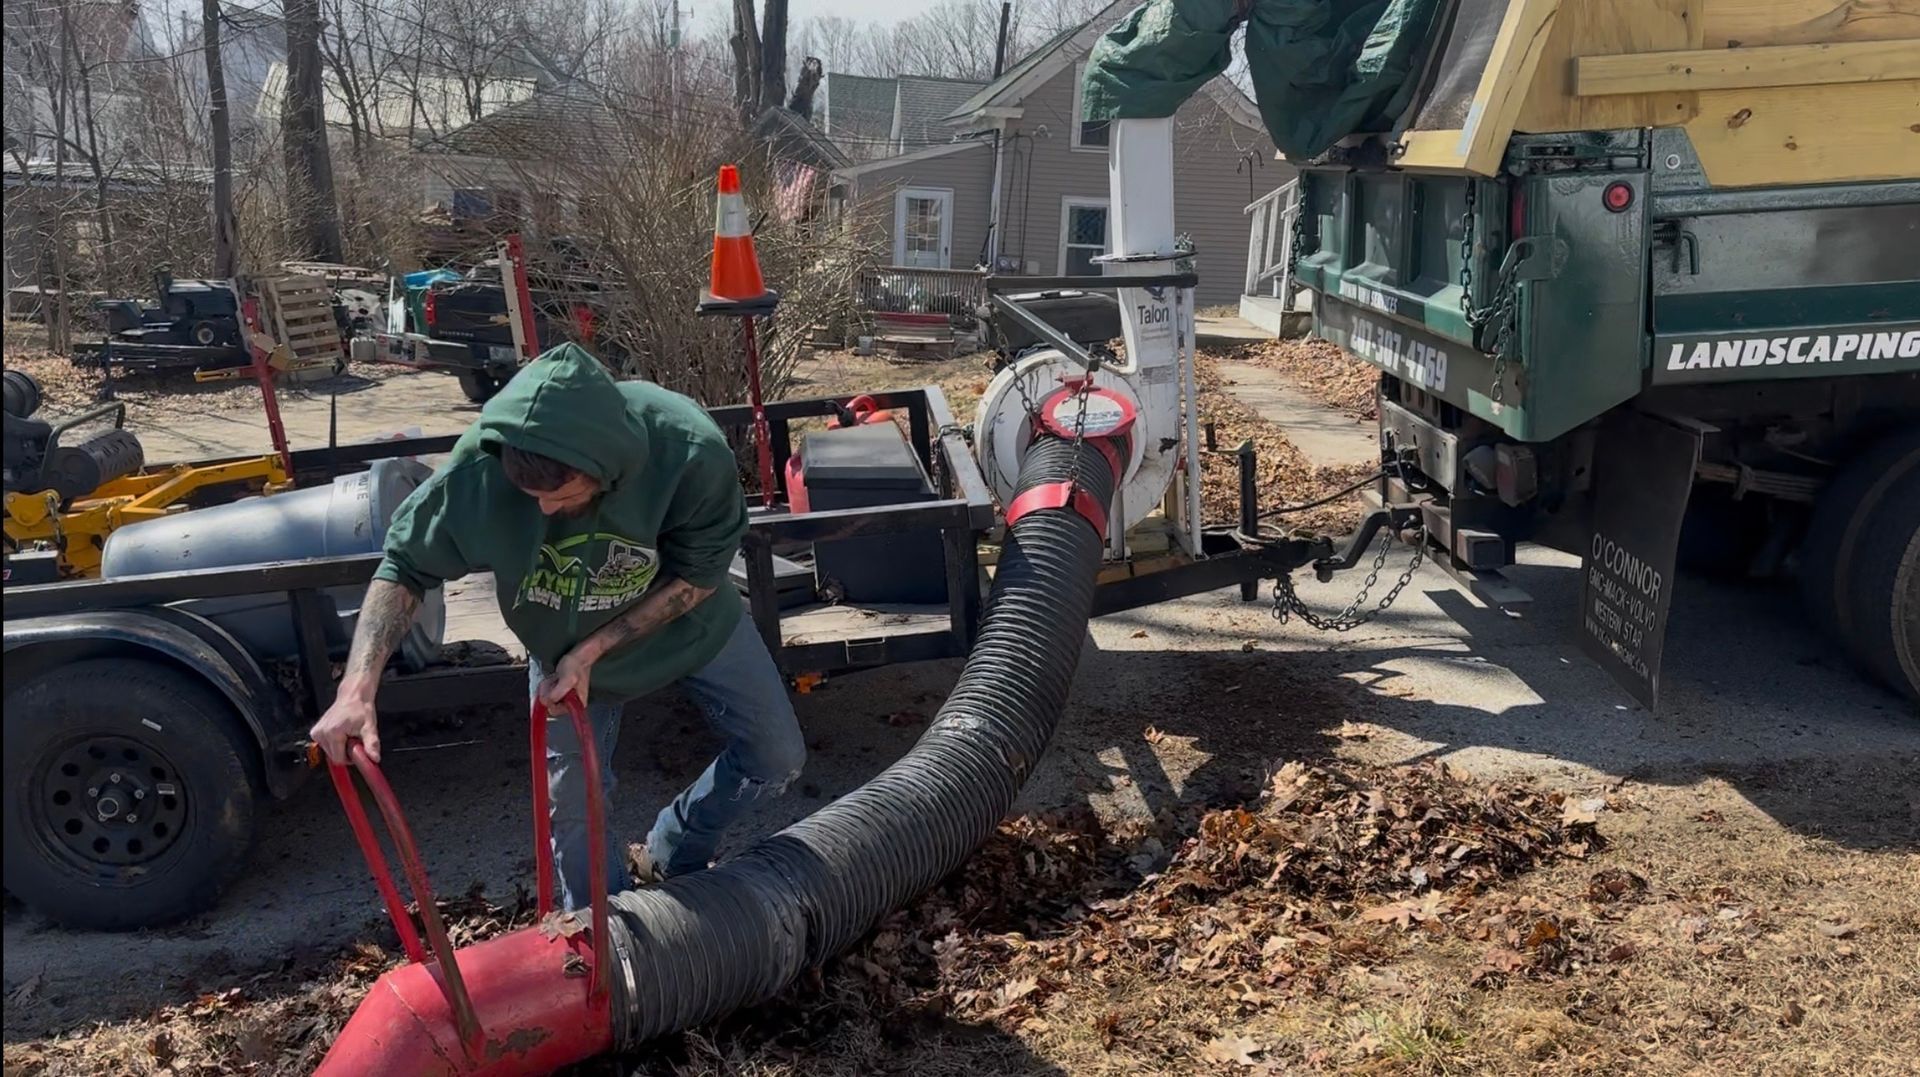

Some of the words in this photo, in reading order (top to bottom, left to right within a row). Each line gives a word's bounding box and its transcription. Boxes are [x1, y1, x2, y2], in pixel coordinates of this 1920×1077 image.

[1138, 304, 1169, 325] Talon
[1666, 331, 1920, 370] LANDSCAPING
[1592, 532, 1662, 604] O'CONNOR
[1623, 621, 1643, 649] STAR
